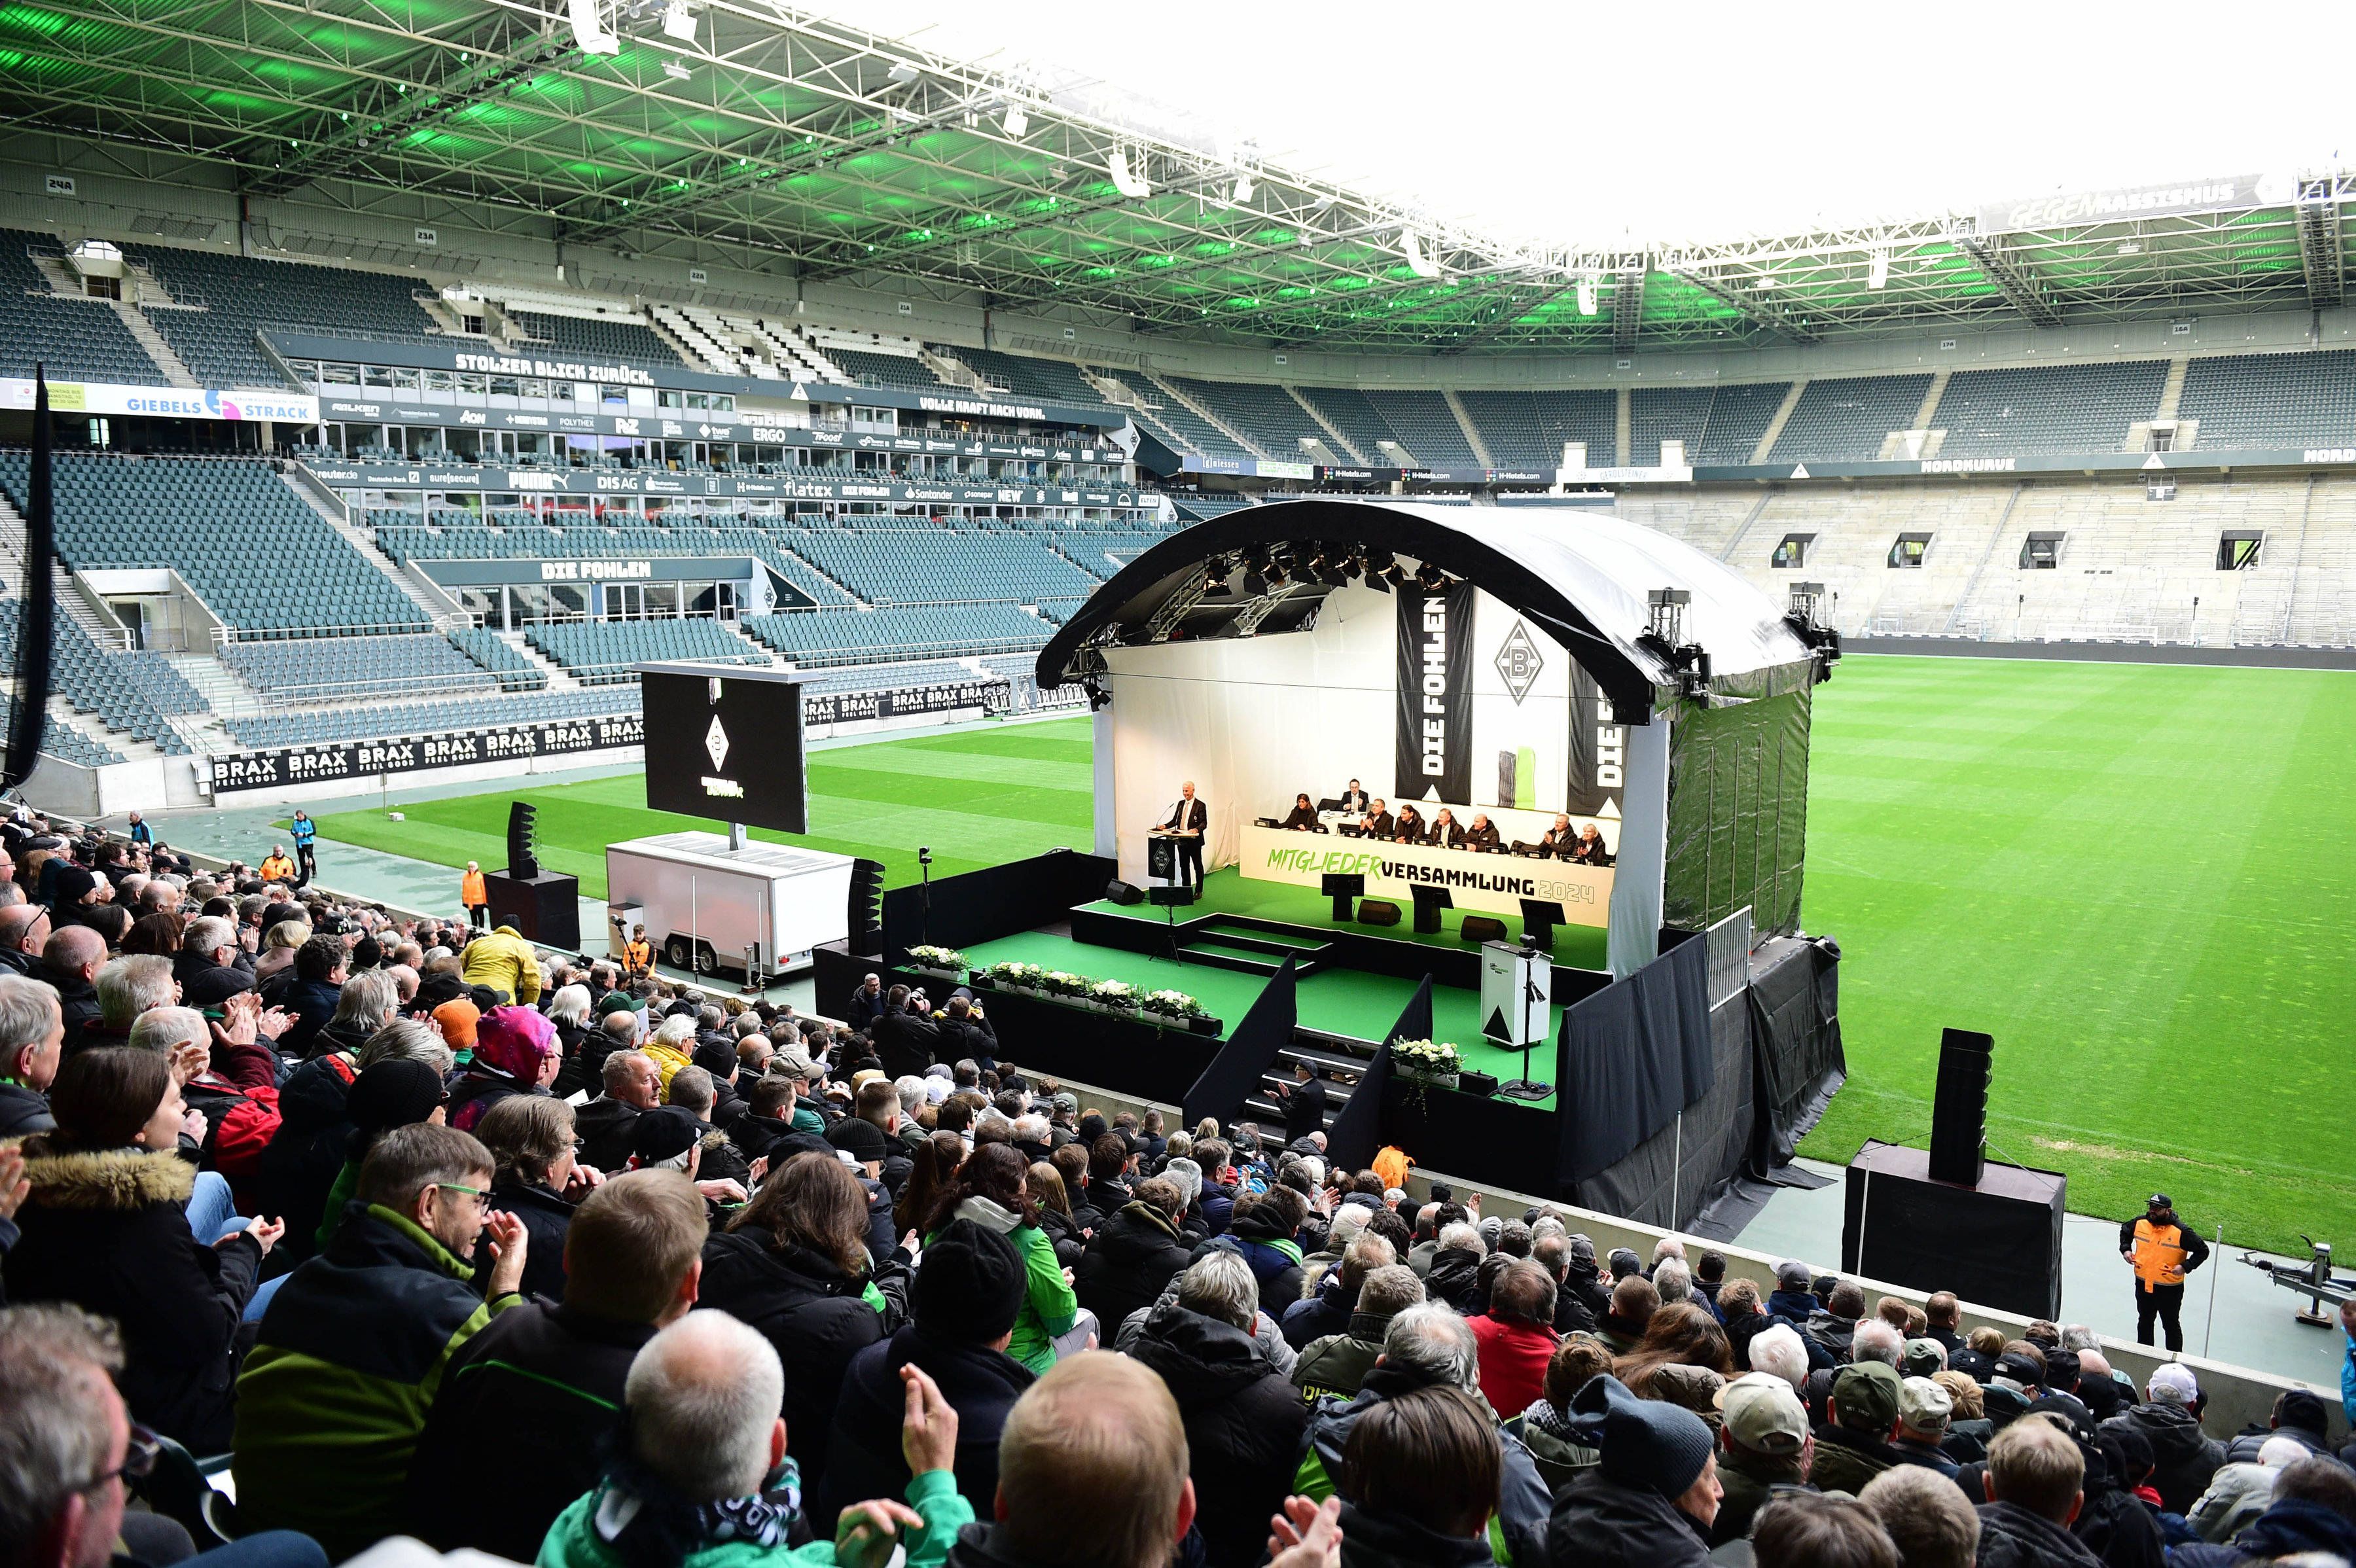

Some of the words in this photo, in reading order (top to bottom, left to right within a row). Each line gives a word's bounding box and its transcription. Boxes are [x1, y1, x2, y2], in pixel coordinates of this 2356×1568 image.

[49, 179, 72, 190] 24A
[418, 232, 434, 240] 23A
[455, 354, 532, 375] STOLZER
[535, 361, 586, 380] BLICK
[589, 365, 654, 385] ZURÜCK.
[127, 399, 201, 414] GIEBELS
[245, 405, 308, 419] STRACK
[332, 404, 380, 413] FALKEN
[919, 397, 954, 412] VOLLE
[955, 401, 988, 416] KRAFT
[990, 404, 1015, 417] NACH
[1017, 406, 1045, 419] VORN.
[560, 418, 594, 427] POLYTHEX
[753, 428, 785, 443] ERGO
[1921, 458, 2016, 472] NORDKURVE
[317, 470, 358, 480] reuter.de
[429, 472, 479, 485] sure[secure]
[509, 472, 555, 490] PUMA
[915, 488, 953, 500] Santander
[971, 491, 993, 499] sonepar
[541, 562, 578, 580] DIE
[580, 561, 651, 579] FOHLEN
[1423, 597, 1446, 714] FOHLEN
[892, 693, 923, 707] BRAX
[927, 690, 957, 703] BRAX
[841, 698, 874, 712] BRAX
[544, 726, 592, 744] BRAX
[600, 721, 644, 738] BRAX
[424, 738, 476, 757] BRAX
[486, 732, 535, 750] BRAX
[569, 739, 592, 748] GOOD
[1422, 719, 1445, 776] DIE
[359, 745, 414, 764] BRAX
[425, 755, 448, 764] FEEL
[452, 752, 477, 761] GOOD
[487, 749, 509, 757] FEEL
[512, 745, 537, 754] GOOD
[1597, 726, 1622, 788] DIE
[214, 758, 276, 779] BRAX
[288, 751, 347, 772] BRAX
[359, 762, 384, 772] FEEL
[387, 759, 415, 768] GOOD
[290, 770, 315, 779] FEEL
[320, 766, 348, 776] GOOD
[216, 778, 242, 787] FEEL
[247, 774, 277, 783] GOOD
[1539, 880, 1595, 904] 2024
